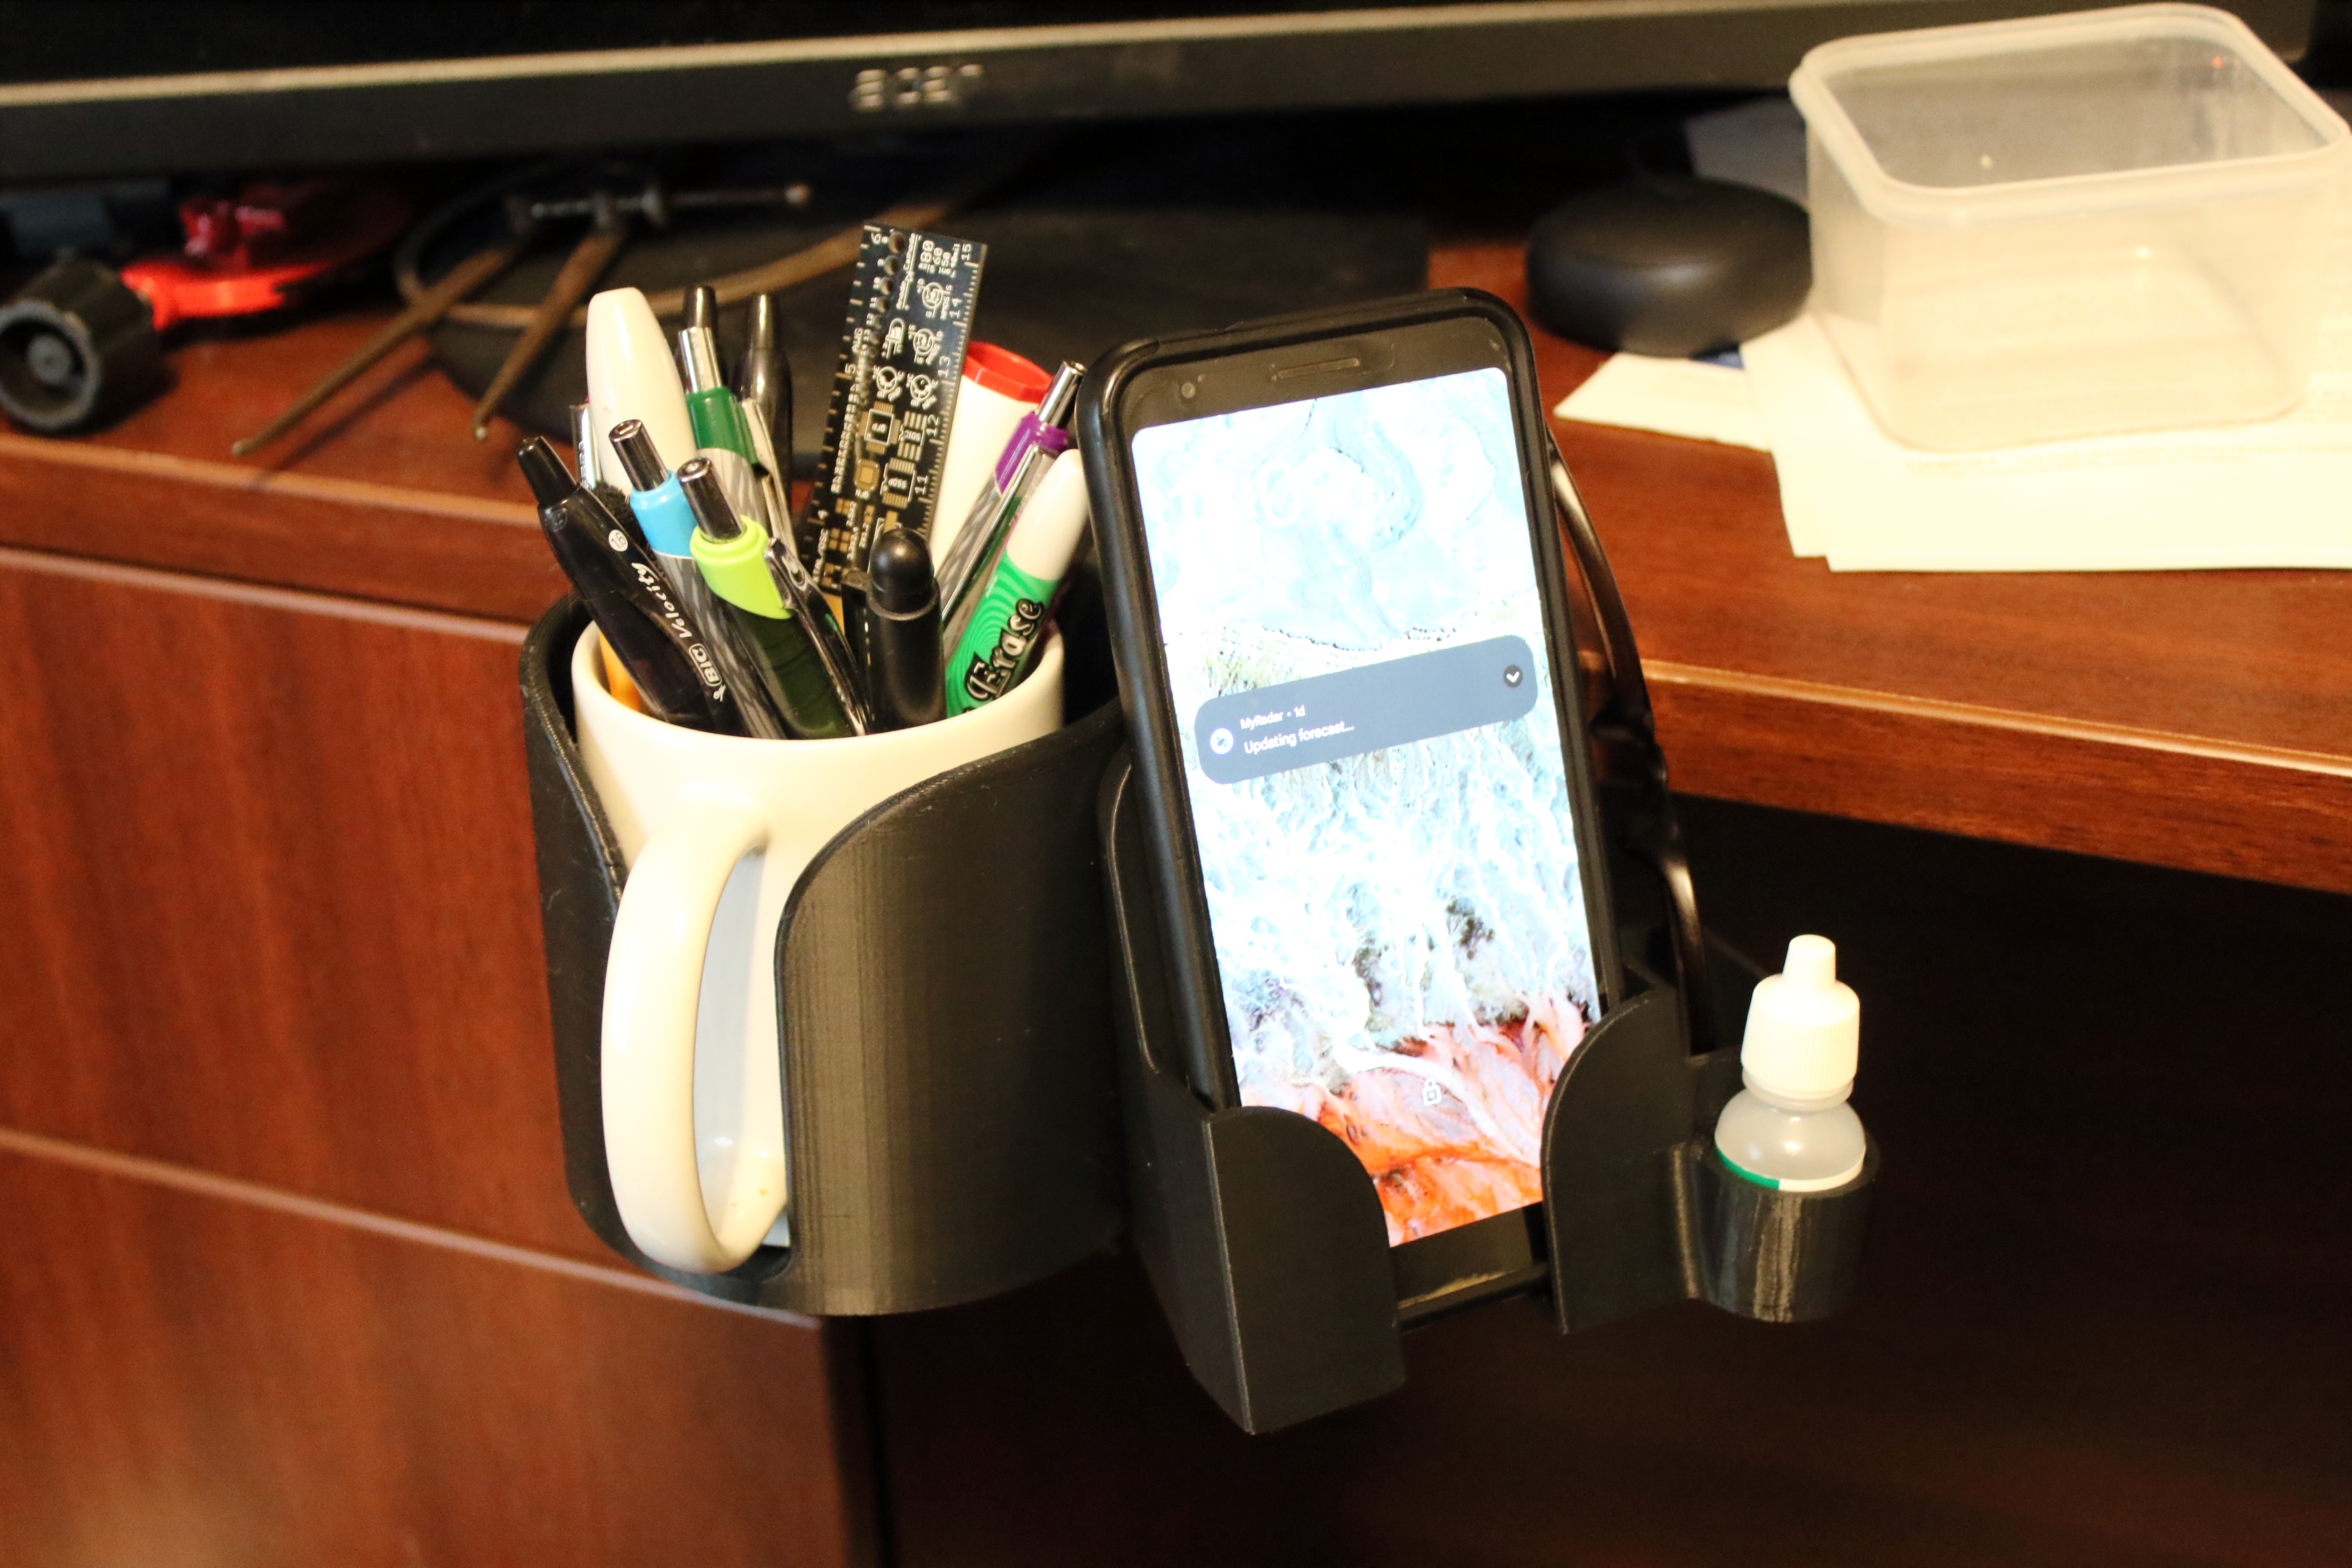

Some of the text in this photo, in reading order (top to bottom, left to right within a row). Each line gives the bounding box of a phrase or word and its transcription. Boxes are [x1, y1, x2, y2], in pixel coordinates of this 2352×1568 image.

[961, 243, 972, 262] 15
[869, 297, 877, 308] 11
[949, 298, 962, 319] 14
[844, 363, 857, 375] 5
[937, 355, 951, 379] 13
[926, 414, 940, 437] 12
[914, 475, 929, 495] 11
[611, 532, 627, 550] 1.6
[631, 562, 720, 684] BIC Velocity
[964, 598, 1045, 702] Erase
[1240, 704, 1305, 731] MyRadar 1d
[1244, 720, 1355, 755] Updating forecast...
